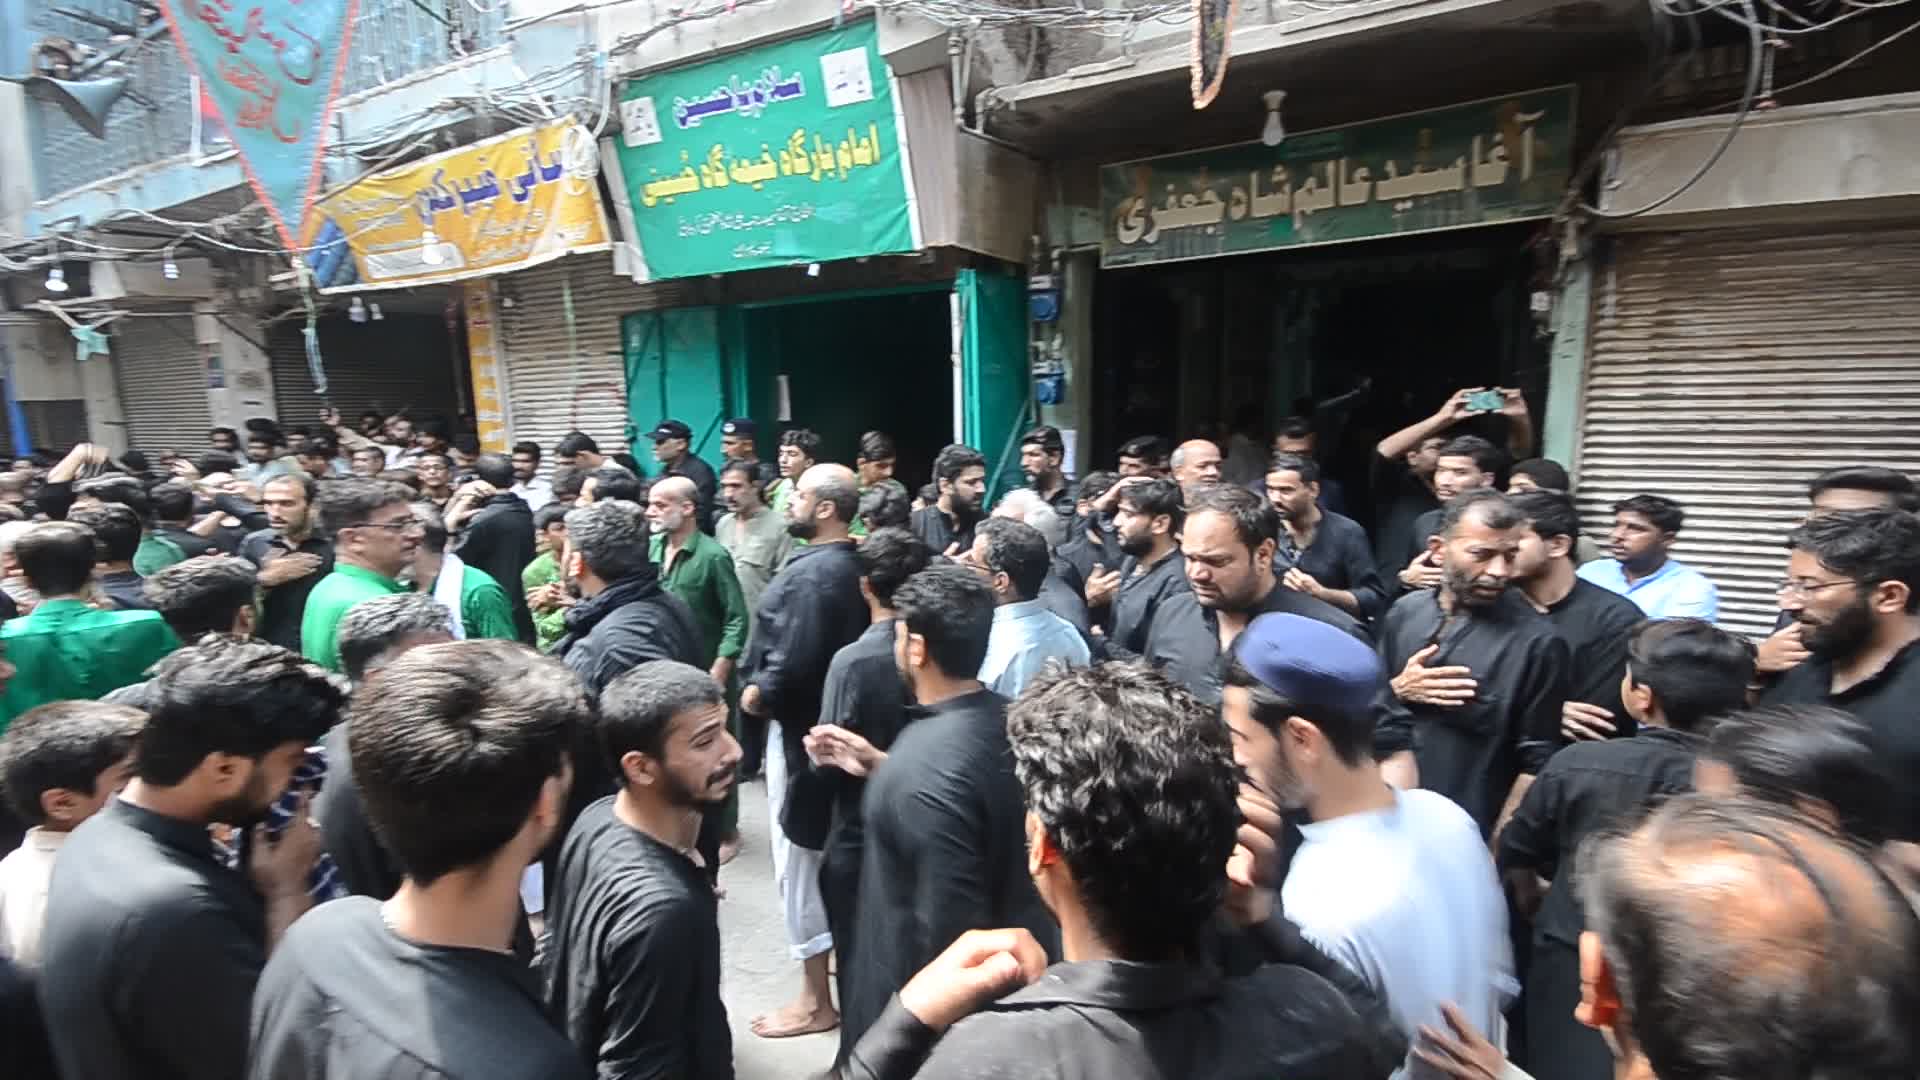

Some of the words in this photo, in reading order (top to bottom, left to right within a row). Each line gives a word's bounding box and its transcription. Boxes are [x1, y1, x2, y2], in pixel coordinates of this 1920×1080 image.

[836, 121, 880, 181] امام
[1472, 110, 1546, 188] آغا
[1117, 183, 1225, 244] جعفری
[1229, 163, 1291, 221] شاہ
[1292, 155, 1371, 231] عالم
